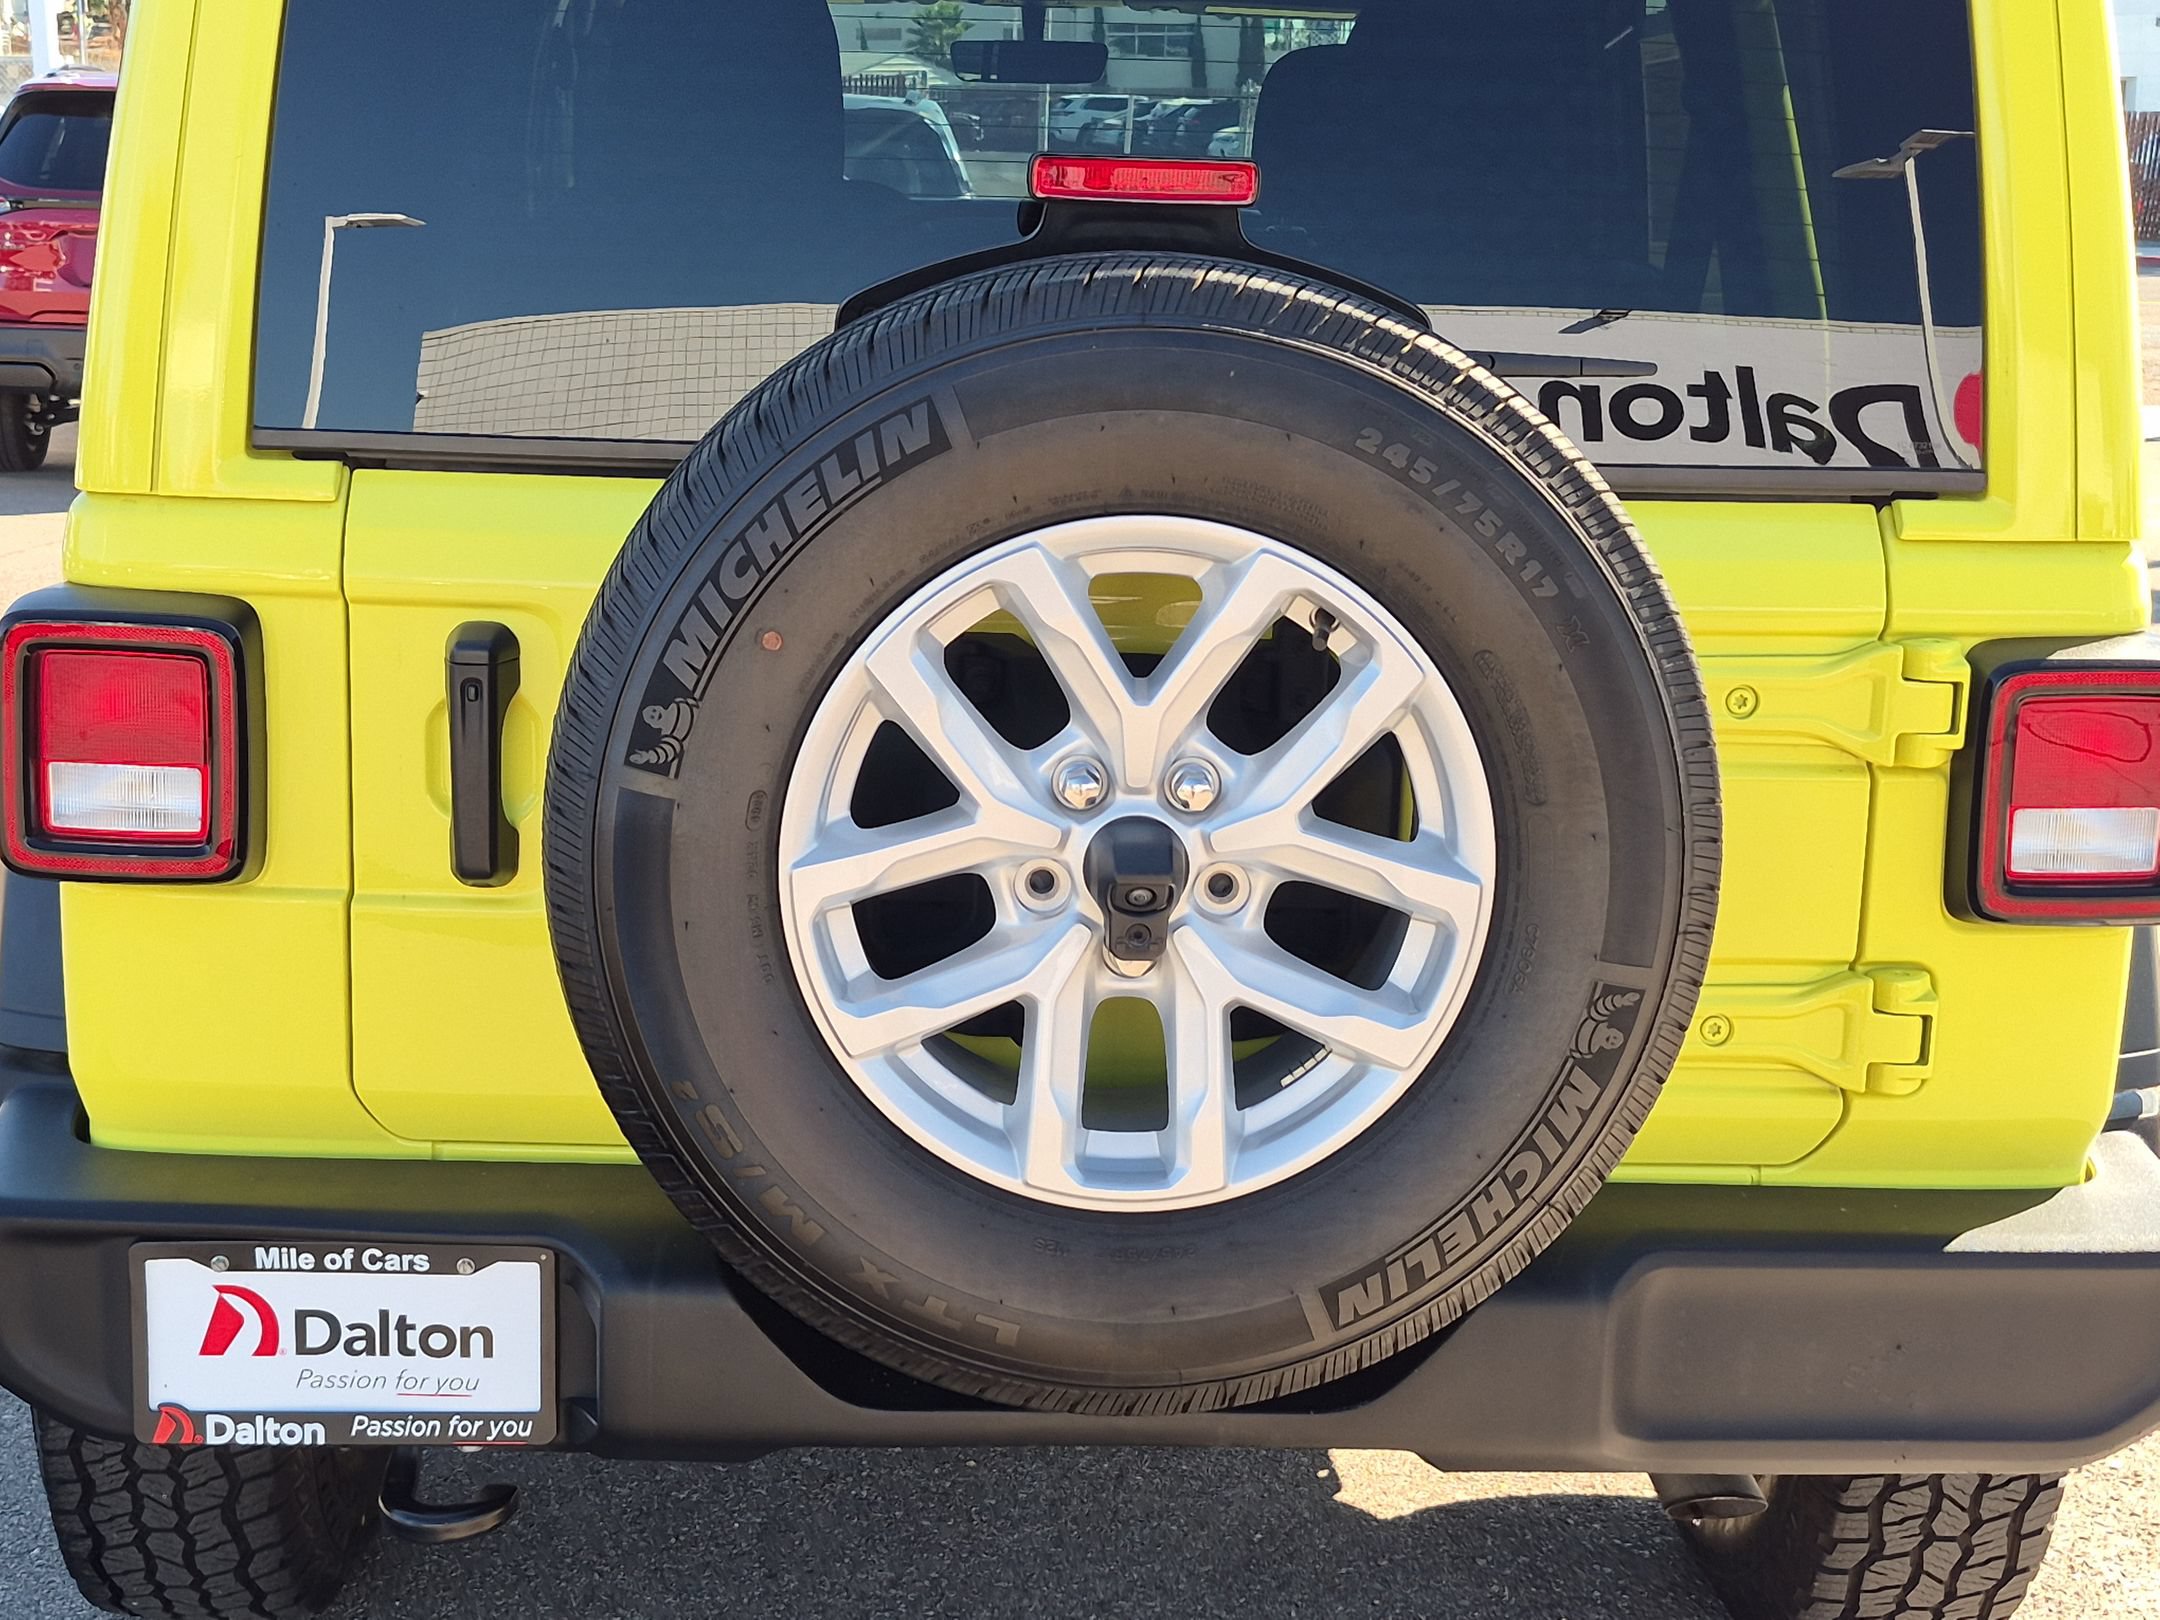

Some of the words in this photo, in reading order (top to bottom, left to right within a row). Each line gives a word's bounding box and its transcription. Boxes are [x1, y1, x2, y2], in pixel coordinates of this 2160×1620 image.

[1354, 427, 1560, 598] 245/75R17
[662, 400, 932, 691] MICHELIN
[1337, 1066, 1602, 1327] MICHELIN
[254, 1246, 316, 1271] Mile
[323, 1248, 354, 1271] of
[361, 1247, 431, 1273] Cars
[846, 1255, 1022, 1348] LTX
[293, 1307, 495, 1359] Dalton
[295, 1368, 387, 1391] Passion
[394, 1369, 427, 1393] for
[434, 1375, 481, 1395] you
[204, 1413, 327, 1446] Dalton
[349, 1414, 442, 1438] Passion
[446, 1414, 485, 1439] for
[486, 1419, 534, 1440] you
